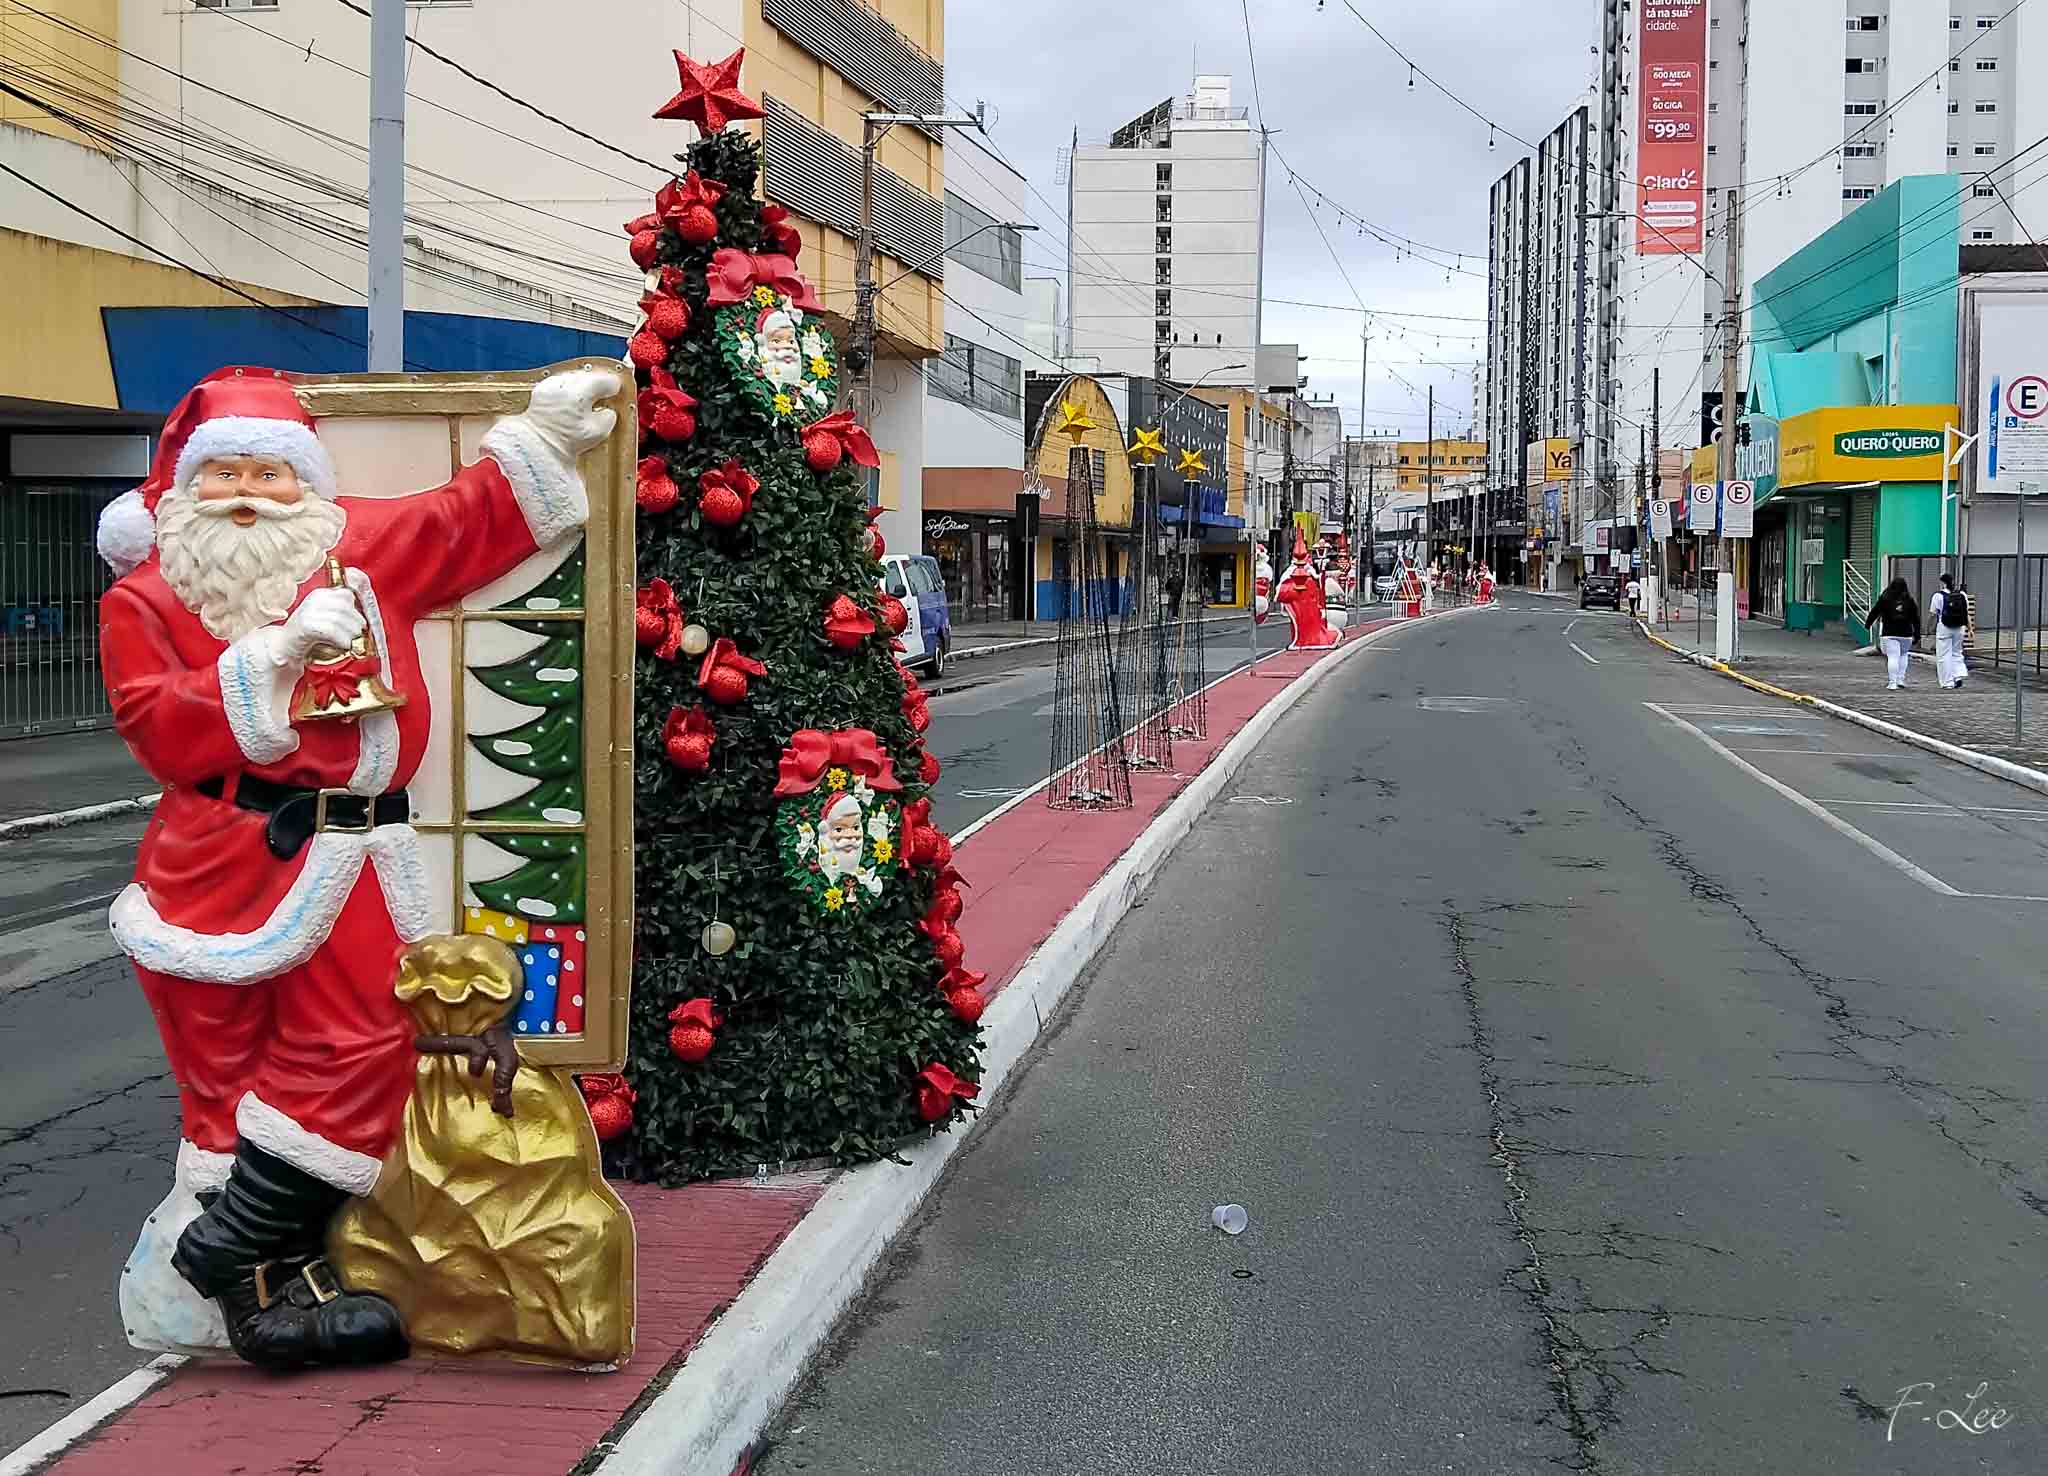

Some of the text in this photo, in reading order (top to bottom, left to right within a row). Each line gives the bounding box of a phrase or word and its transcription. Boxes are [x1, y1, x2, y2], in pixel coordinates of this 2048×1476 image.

[1657, 9, 1670, 18] na
[1646, 20, 1680, 31] cidade.
[1653, 71, 1692, 79] 600 MEGA
[1652, 101, 1683, 110] 60 GIGA
[1643, 175, 1690, 190] Claro
[2021, 385, 2038, 409] E
[1840, 436, 1940, 453] QUERO QUERO
[1700, 488, 1708, 500] E
[1734, 486, 1744, 500] E
[1656, 503, 1663, 513] E
